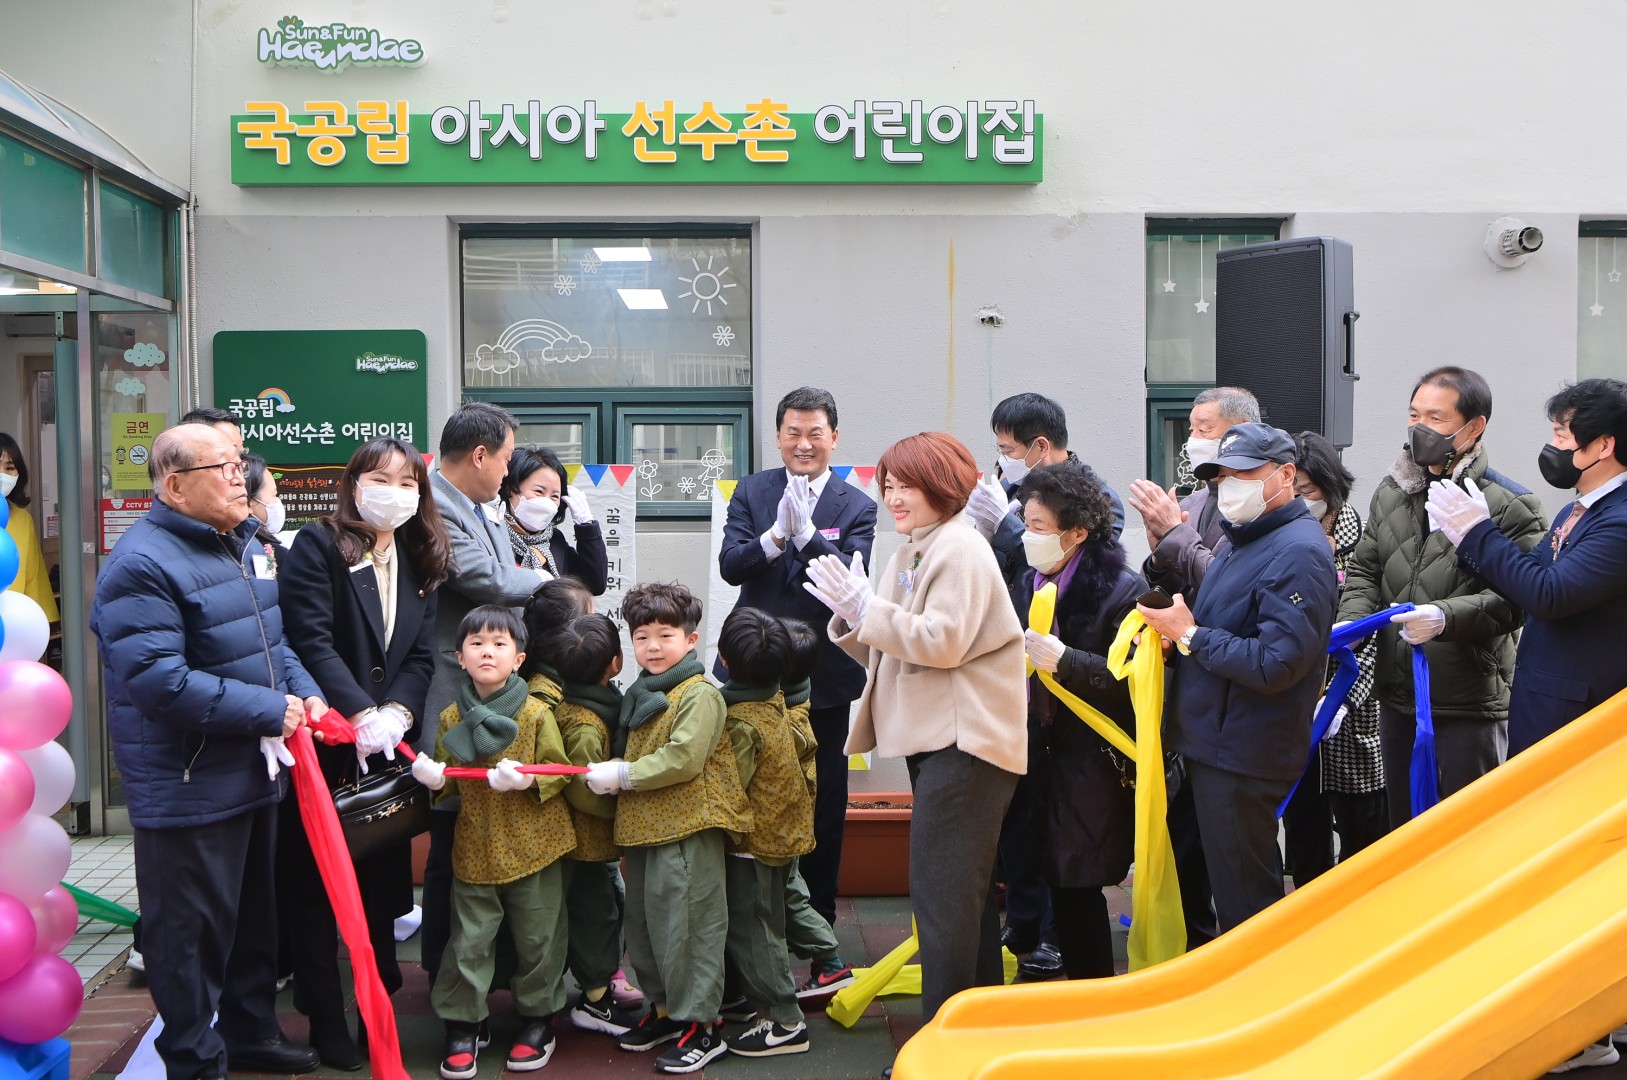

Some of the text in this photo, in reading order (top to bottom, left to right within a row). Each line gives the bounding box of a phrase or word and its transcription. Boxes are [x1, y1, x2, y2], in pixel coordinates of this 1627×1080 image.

[285, 25, 366, 40] Sun&Fun
[260, 30, 421, 68] Haeundae
[237, 98, 1035, 167] 국공립 아시아 선수촌 어린이집
[357, 358, 416, 372] Haeundae
[229, 399, 274, 419] 국공립
[126, 421, 149, 434] 금연
[342, 422, 413, 443] 어린이집
[606, 508, 621, 546] 꿈을
[607, 558, 622, 591] 키워
